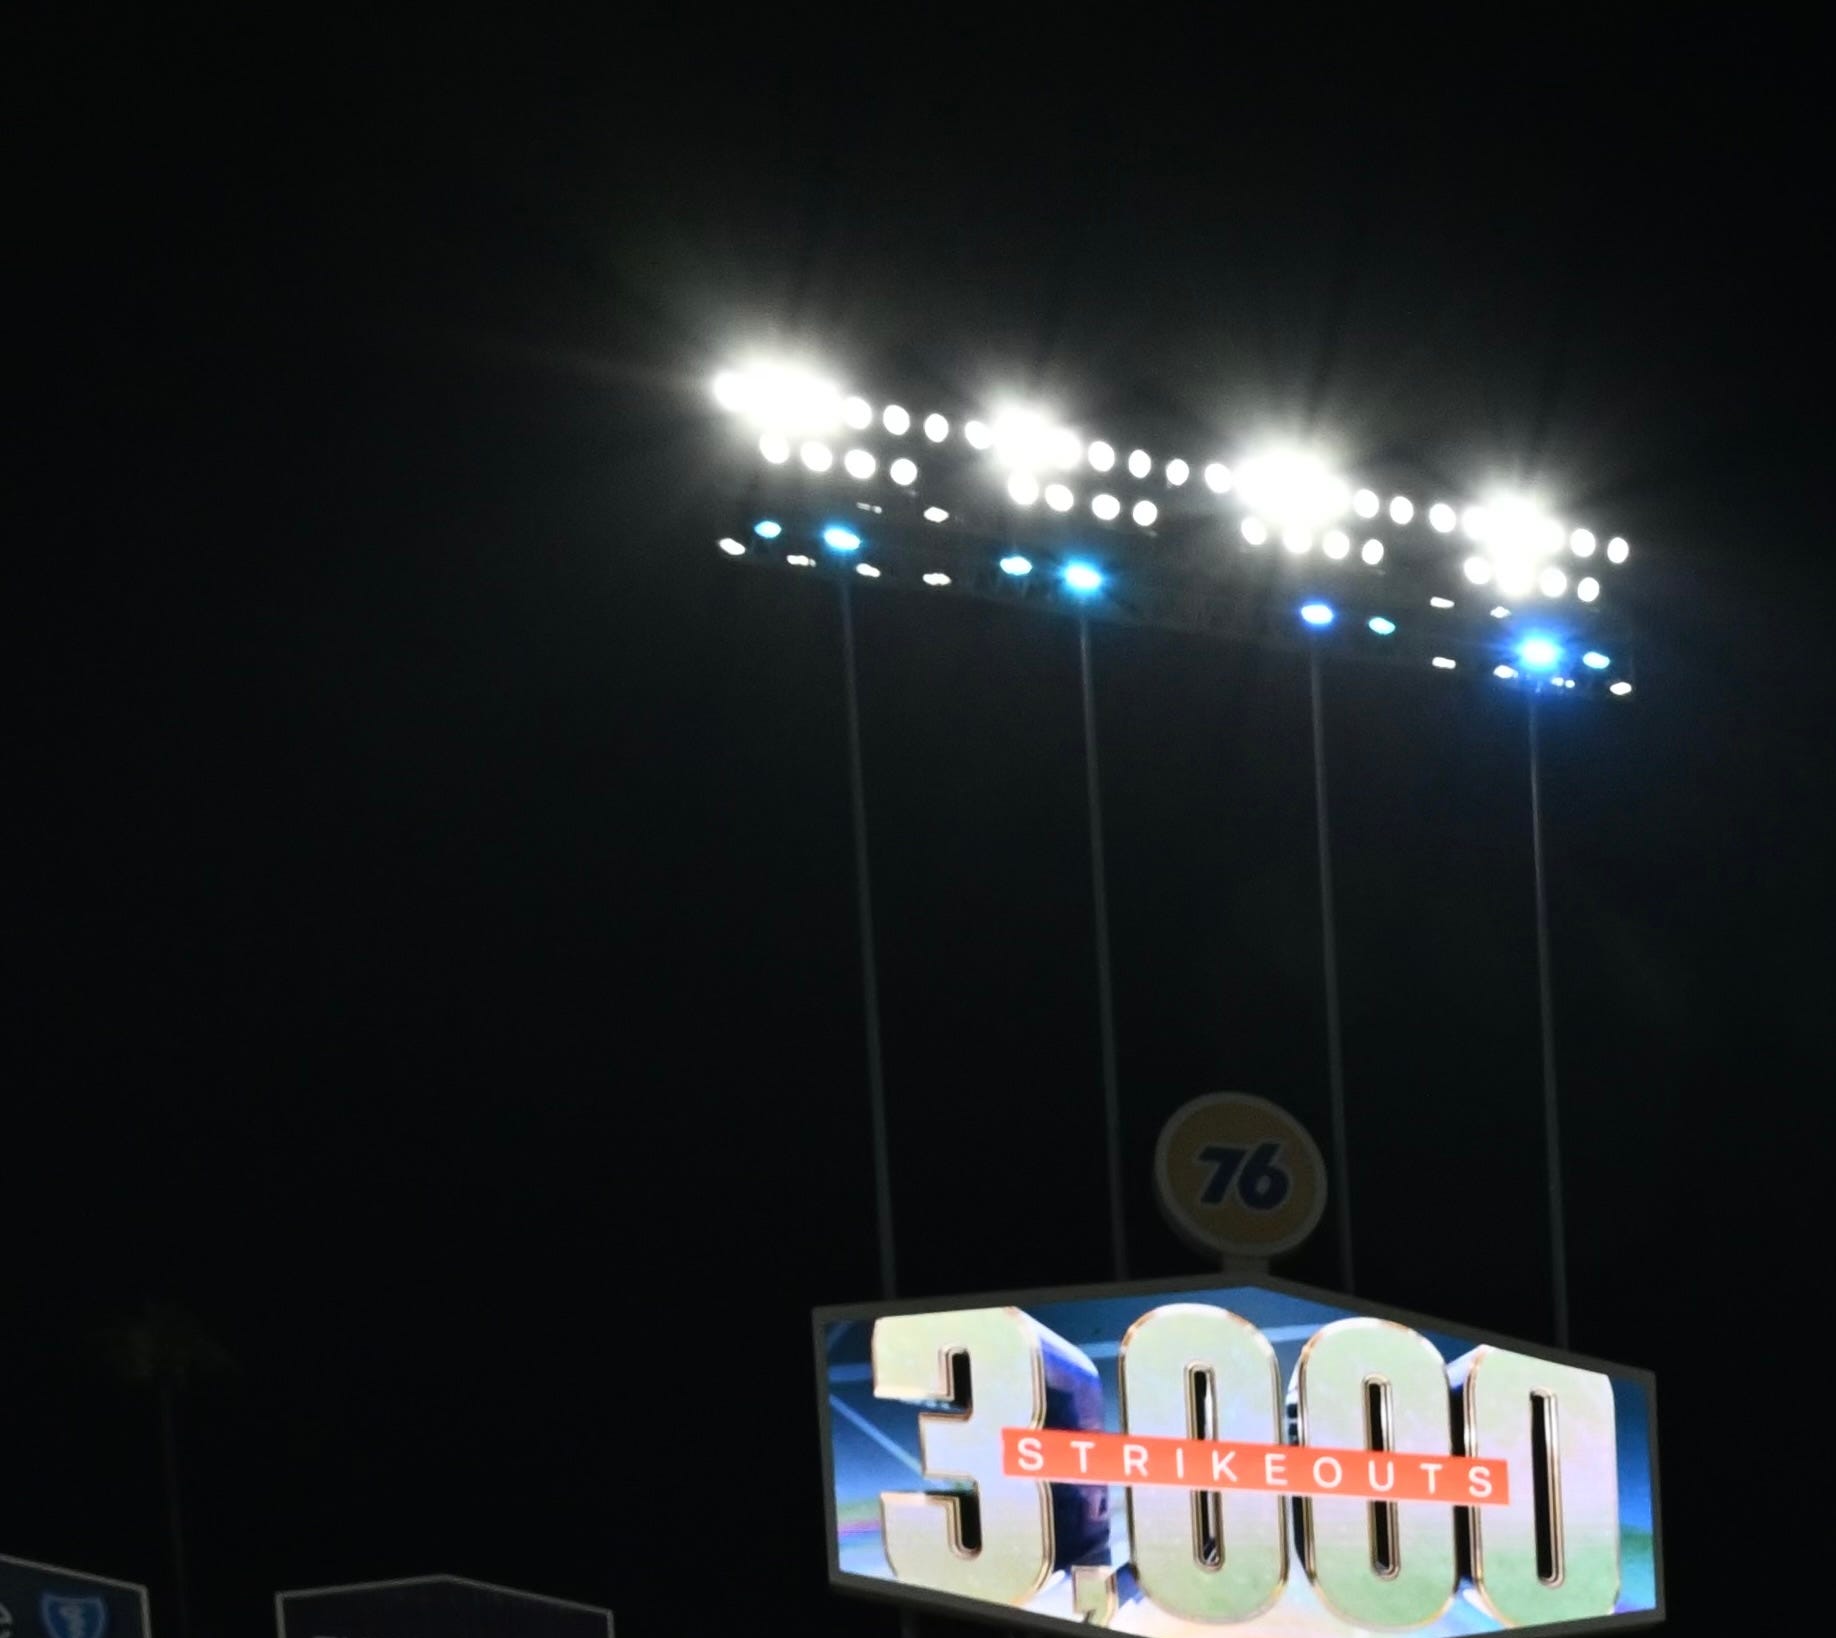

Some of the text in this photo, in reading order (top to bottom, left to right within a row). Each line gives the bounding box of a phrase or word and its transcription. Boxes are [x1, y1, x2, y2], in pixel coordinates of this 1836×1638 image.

[1199, 1142, 1292, 1211] 76
[872, 1303, 1622, 1632] 3,000
[1015, 1437, 1496, 1499] STRIKEOUTS
